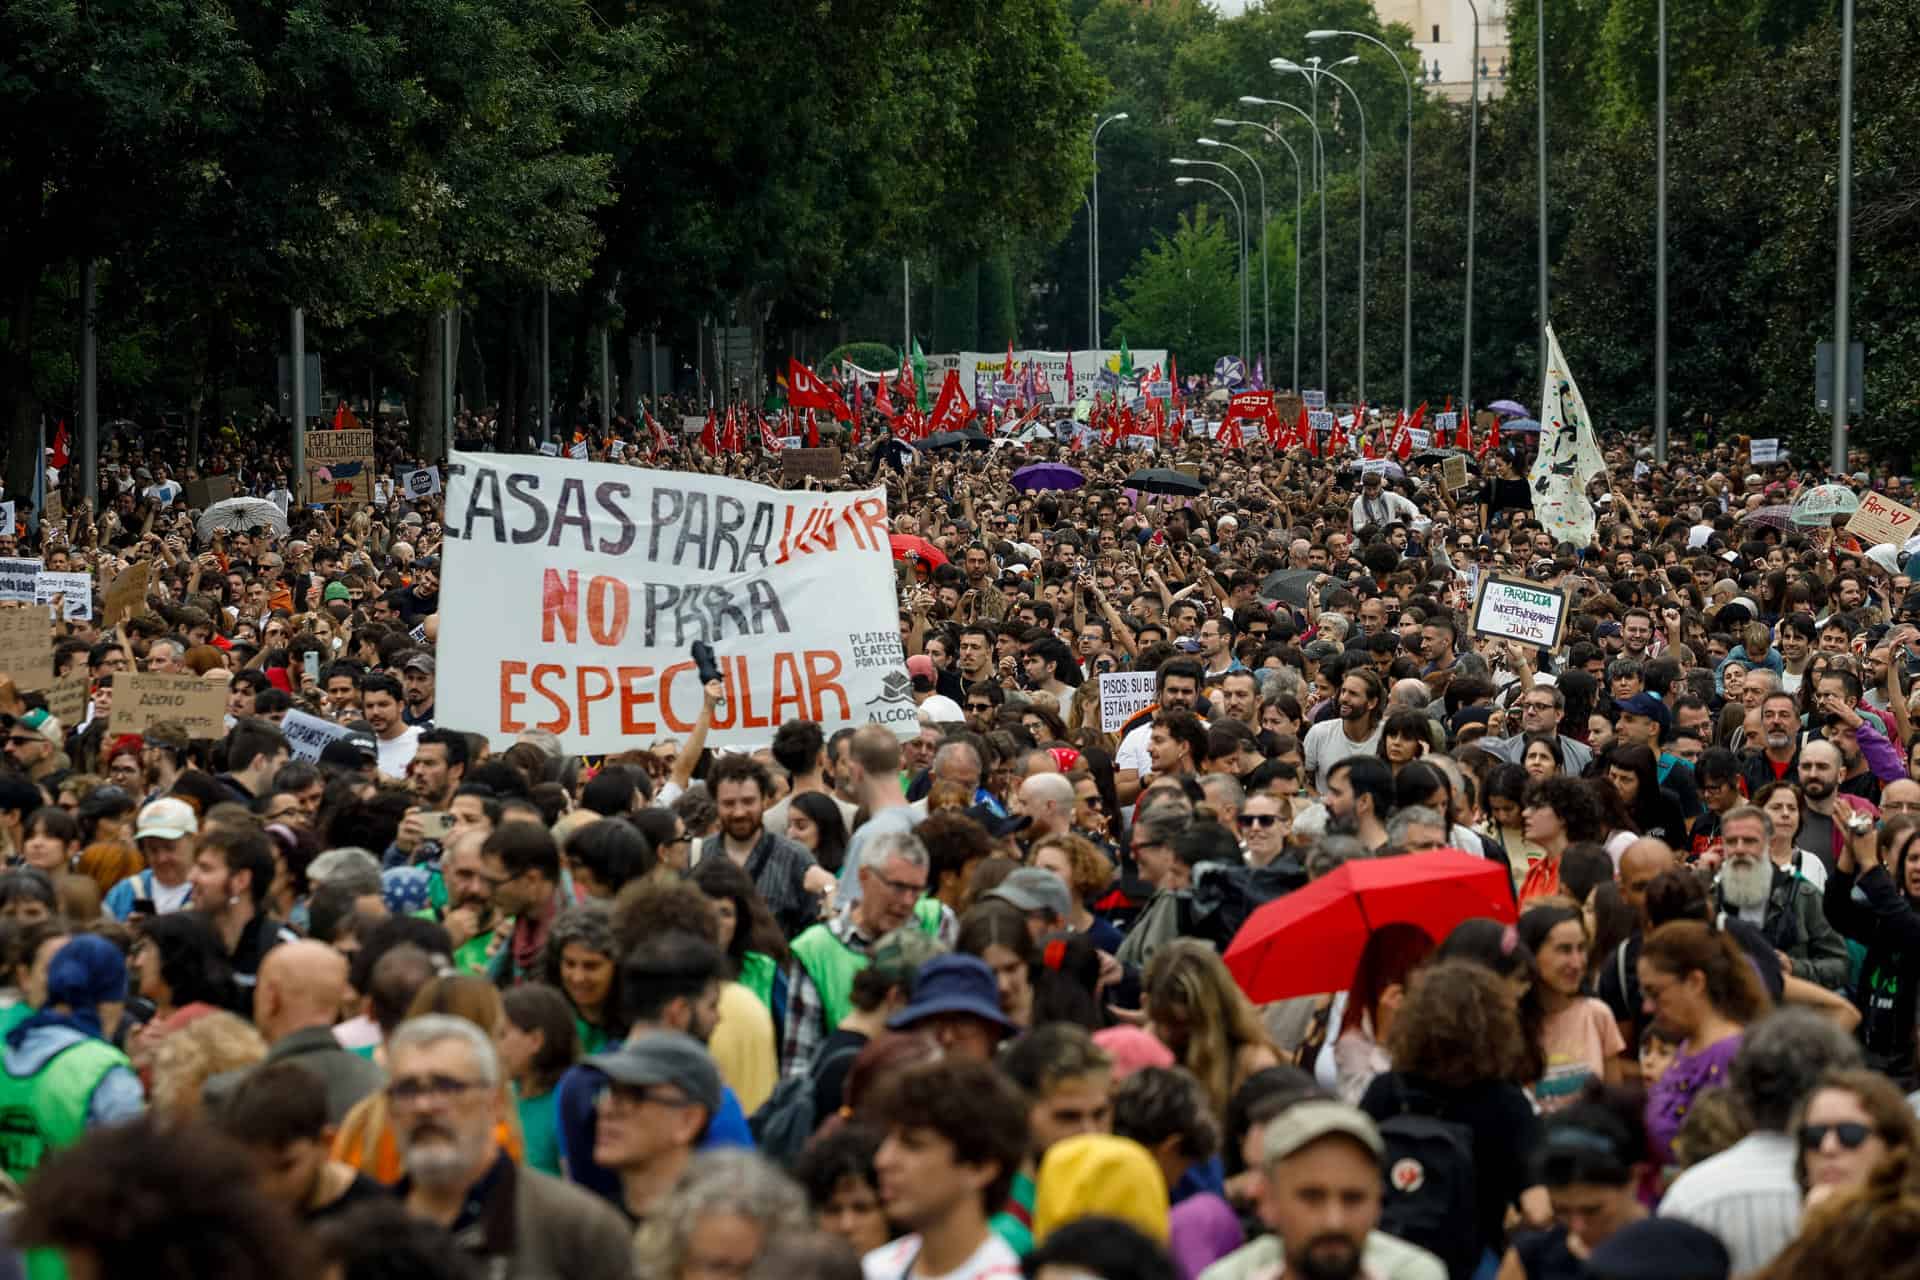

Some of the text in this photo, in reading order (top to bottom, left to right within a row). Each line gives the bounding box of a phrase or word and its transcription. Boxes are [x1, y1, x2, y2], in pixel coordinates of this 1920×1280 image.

[444, 463, 889, 573] CASAS PARA VIVIR
[1890, 508, 1912, 526] 47
[541, 568, 791, 648] NO PARA
[1506, 623, 1544, 639] JUNTS
[853, 644, 902, 658] DE AFECT
[855, 658, 873, 668] POR
[876, 657, 887, 667] LA
[500, 650, 851, 736] ESPECULAR
[1103, 679, 1130, 694] PISOS:
[1131, 678, 1142, 693] SU
